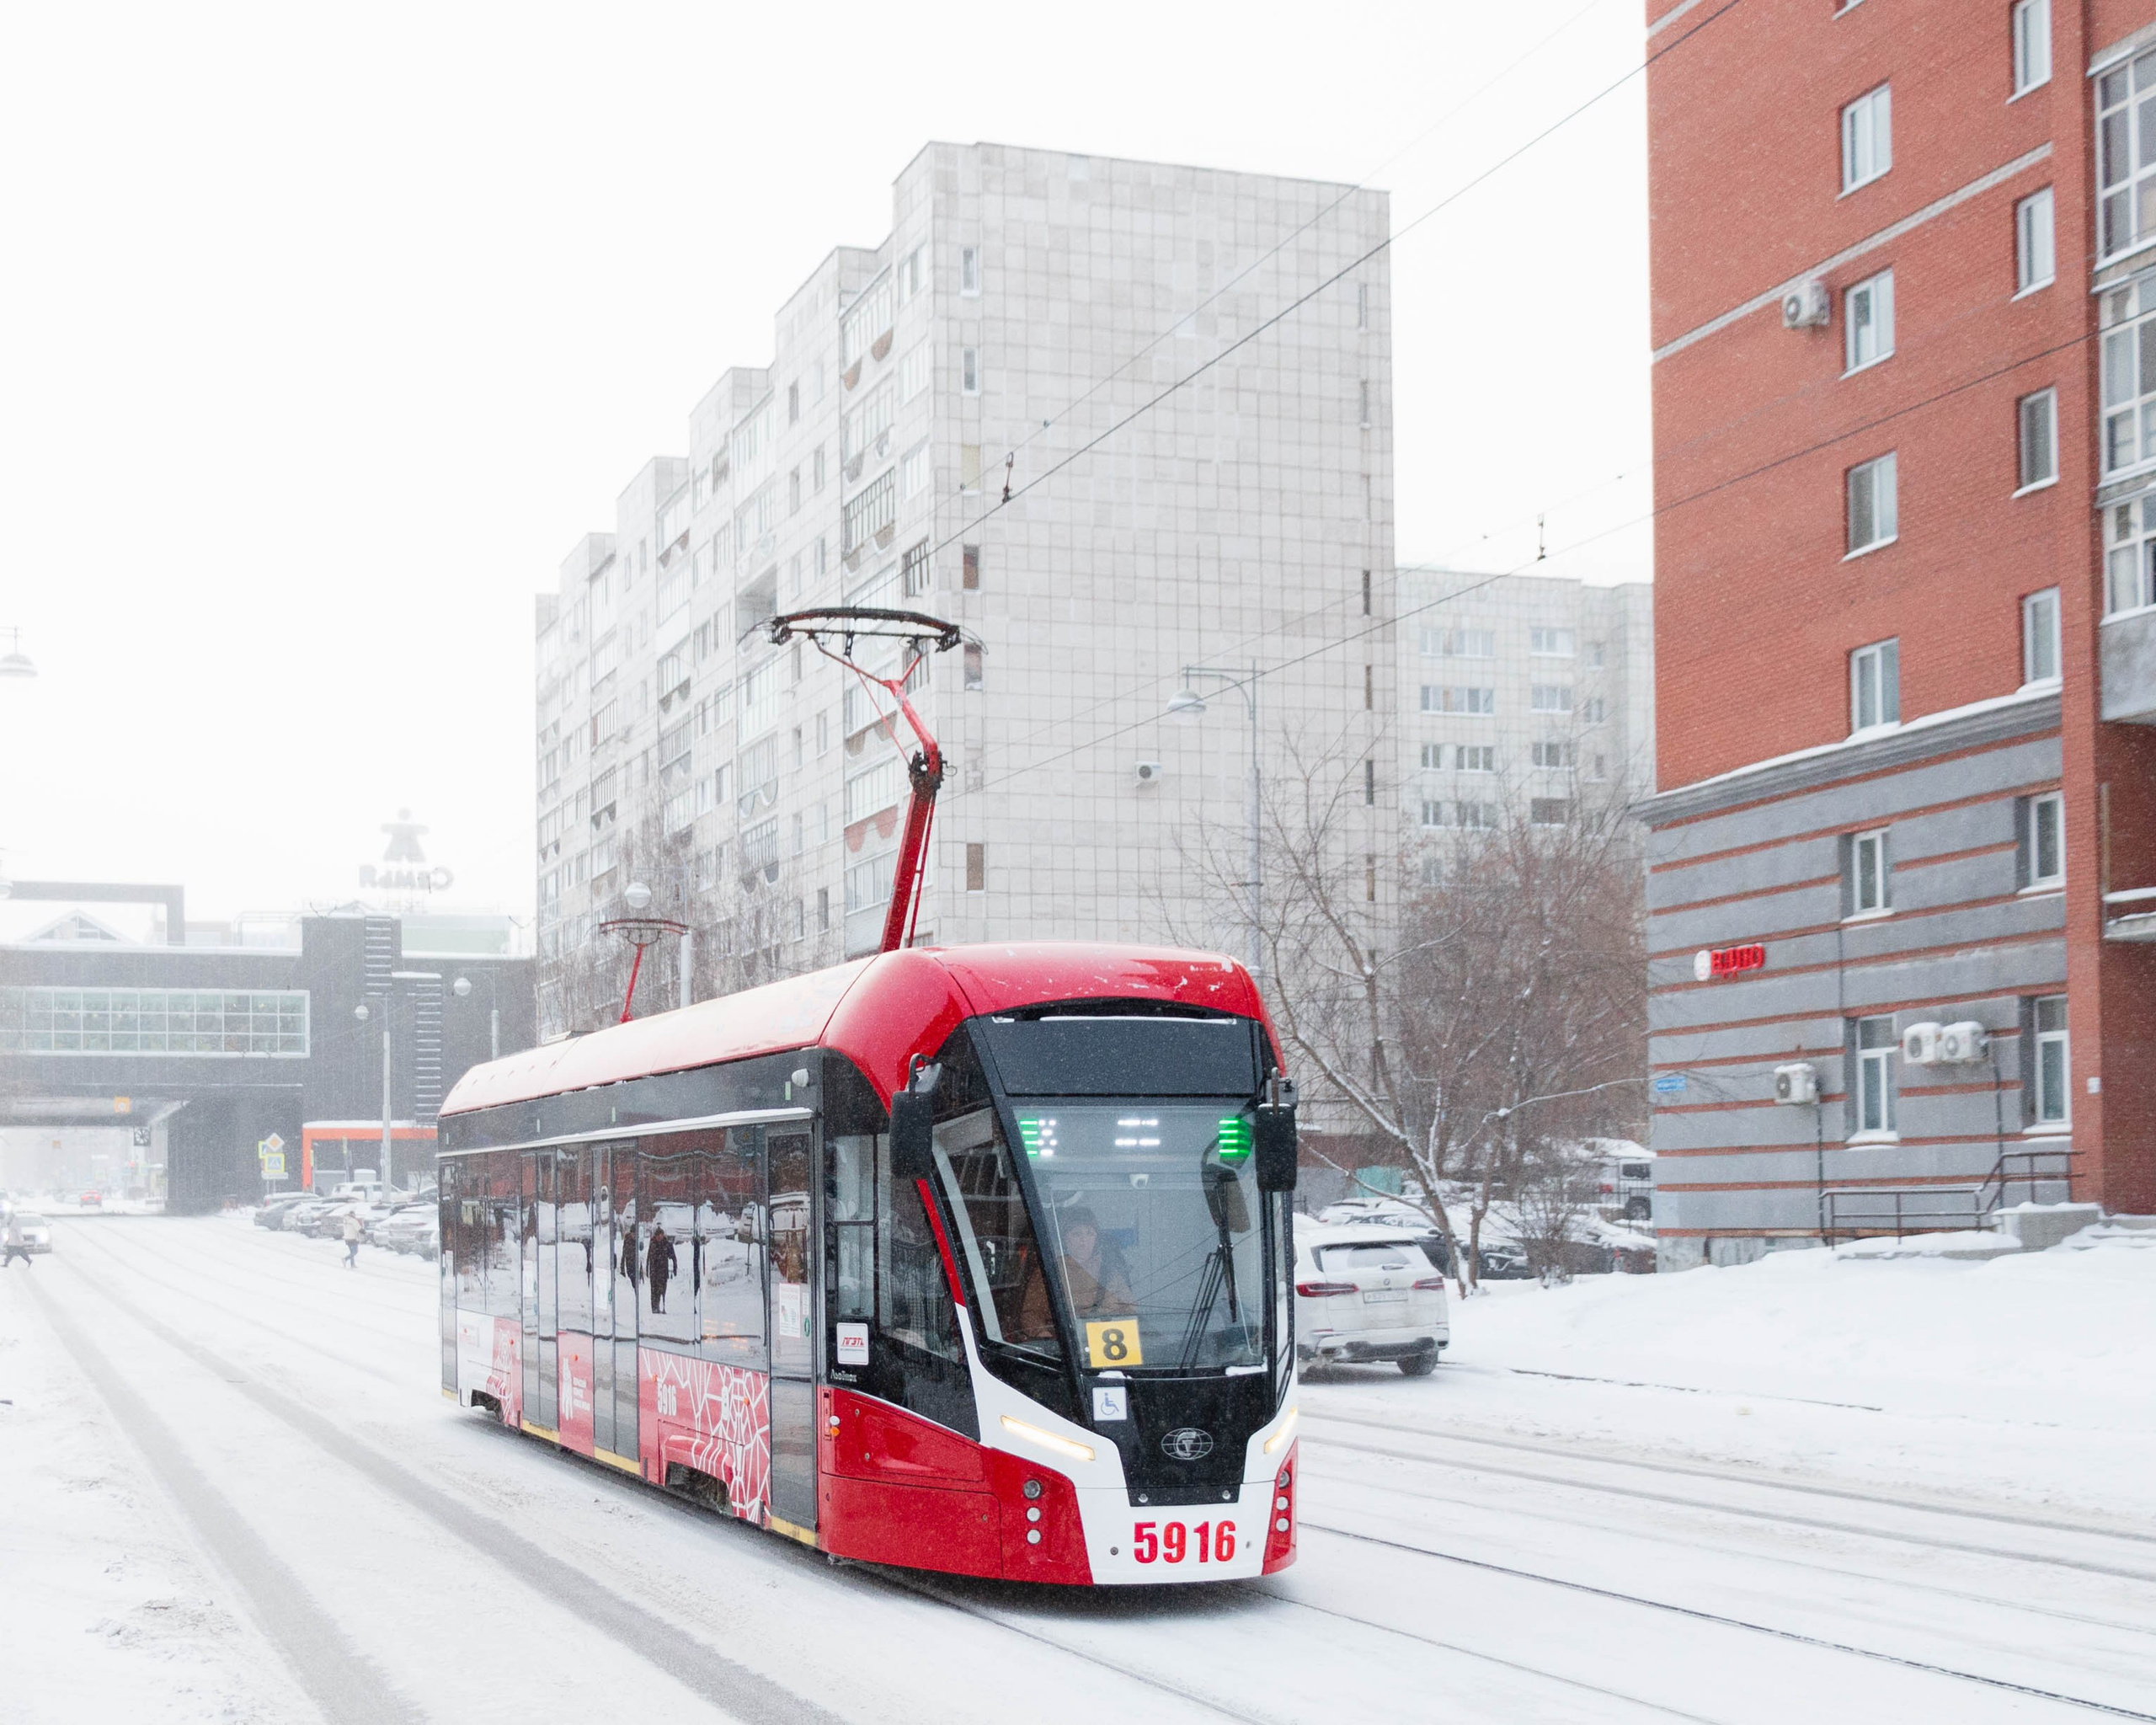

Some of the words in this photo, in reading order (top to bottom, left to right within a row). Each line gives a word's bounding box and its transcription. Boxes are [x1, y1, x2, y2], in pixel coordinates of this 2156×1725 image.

[1102, 1328, 1128, 1361] 8
[657, 1378, 677, 1417] 5916
[1134, 1520, 1235, 1563] 5916
